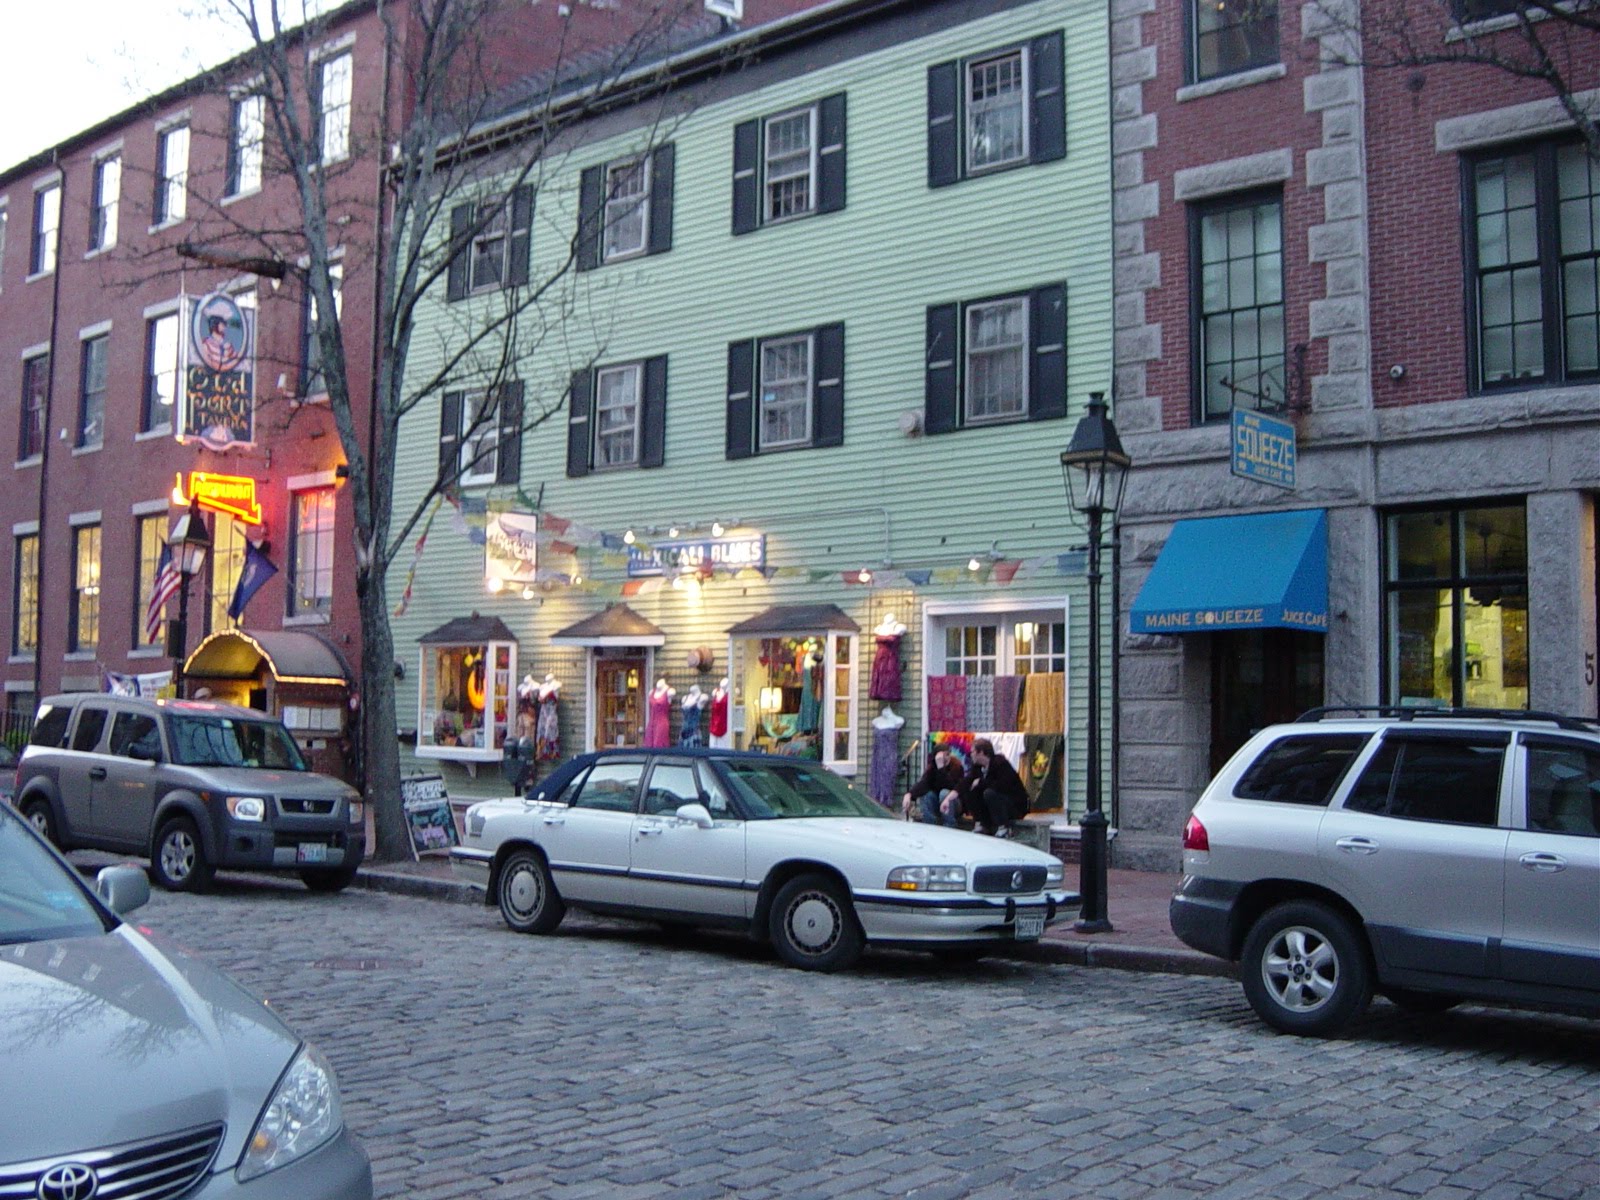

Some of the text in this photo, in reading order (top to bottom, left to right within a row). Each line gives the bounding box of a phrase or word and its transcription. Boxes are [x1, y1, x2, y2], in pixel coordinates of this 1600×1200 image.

[1238, 426, 1293, 471] SQUEEZE
[711, 542, 761, 563] BLUES
[1146, 608, 1264, 627] MAINE SQUEEZE
[1282, 609, 1304, 624] JUICE
